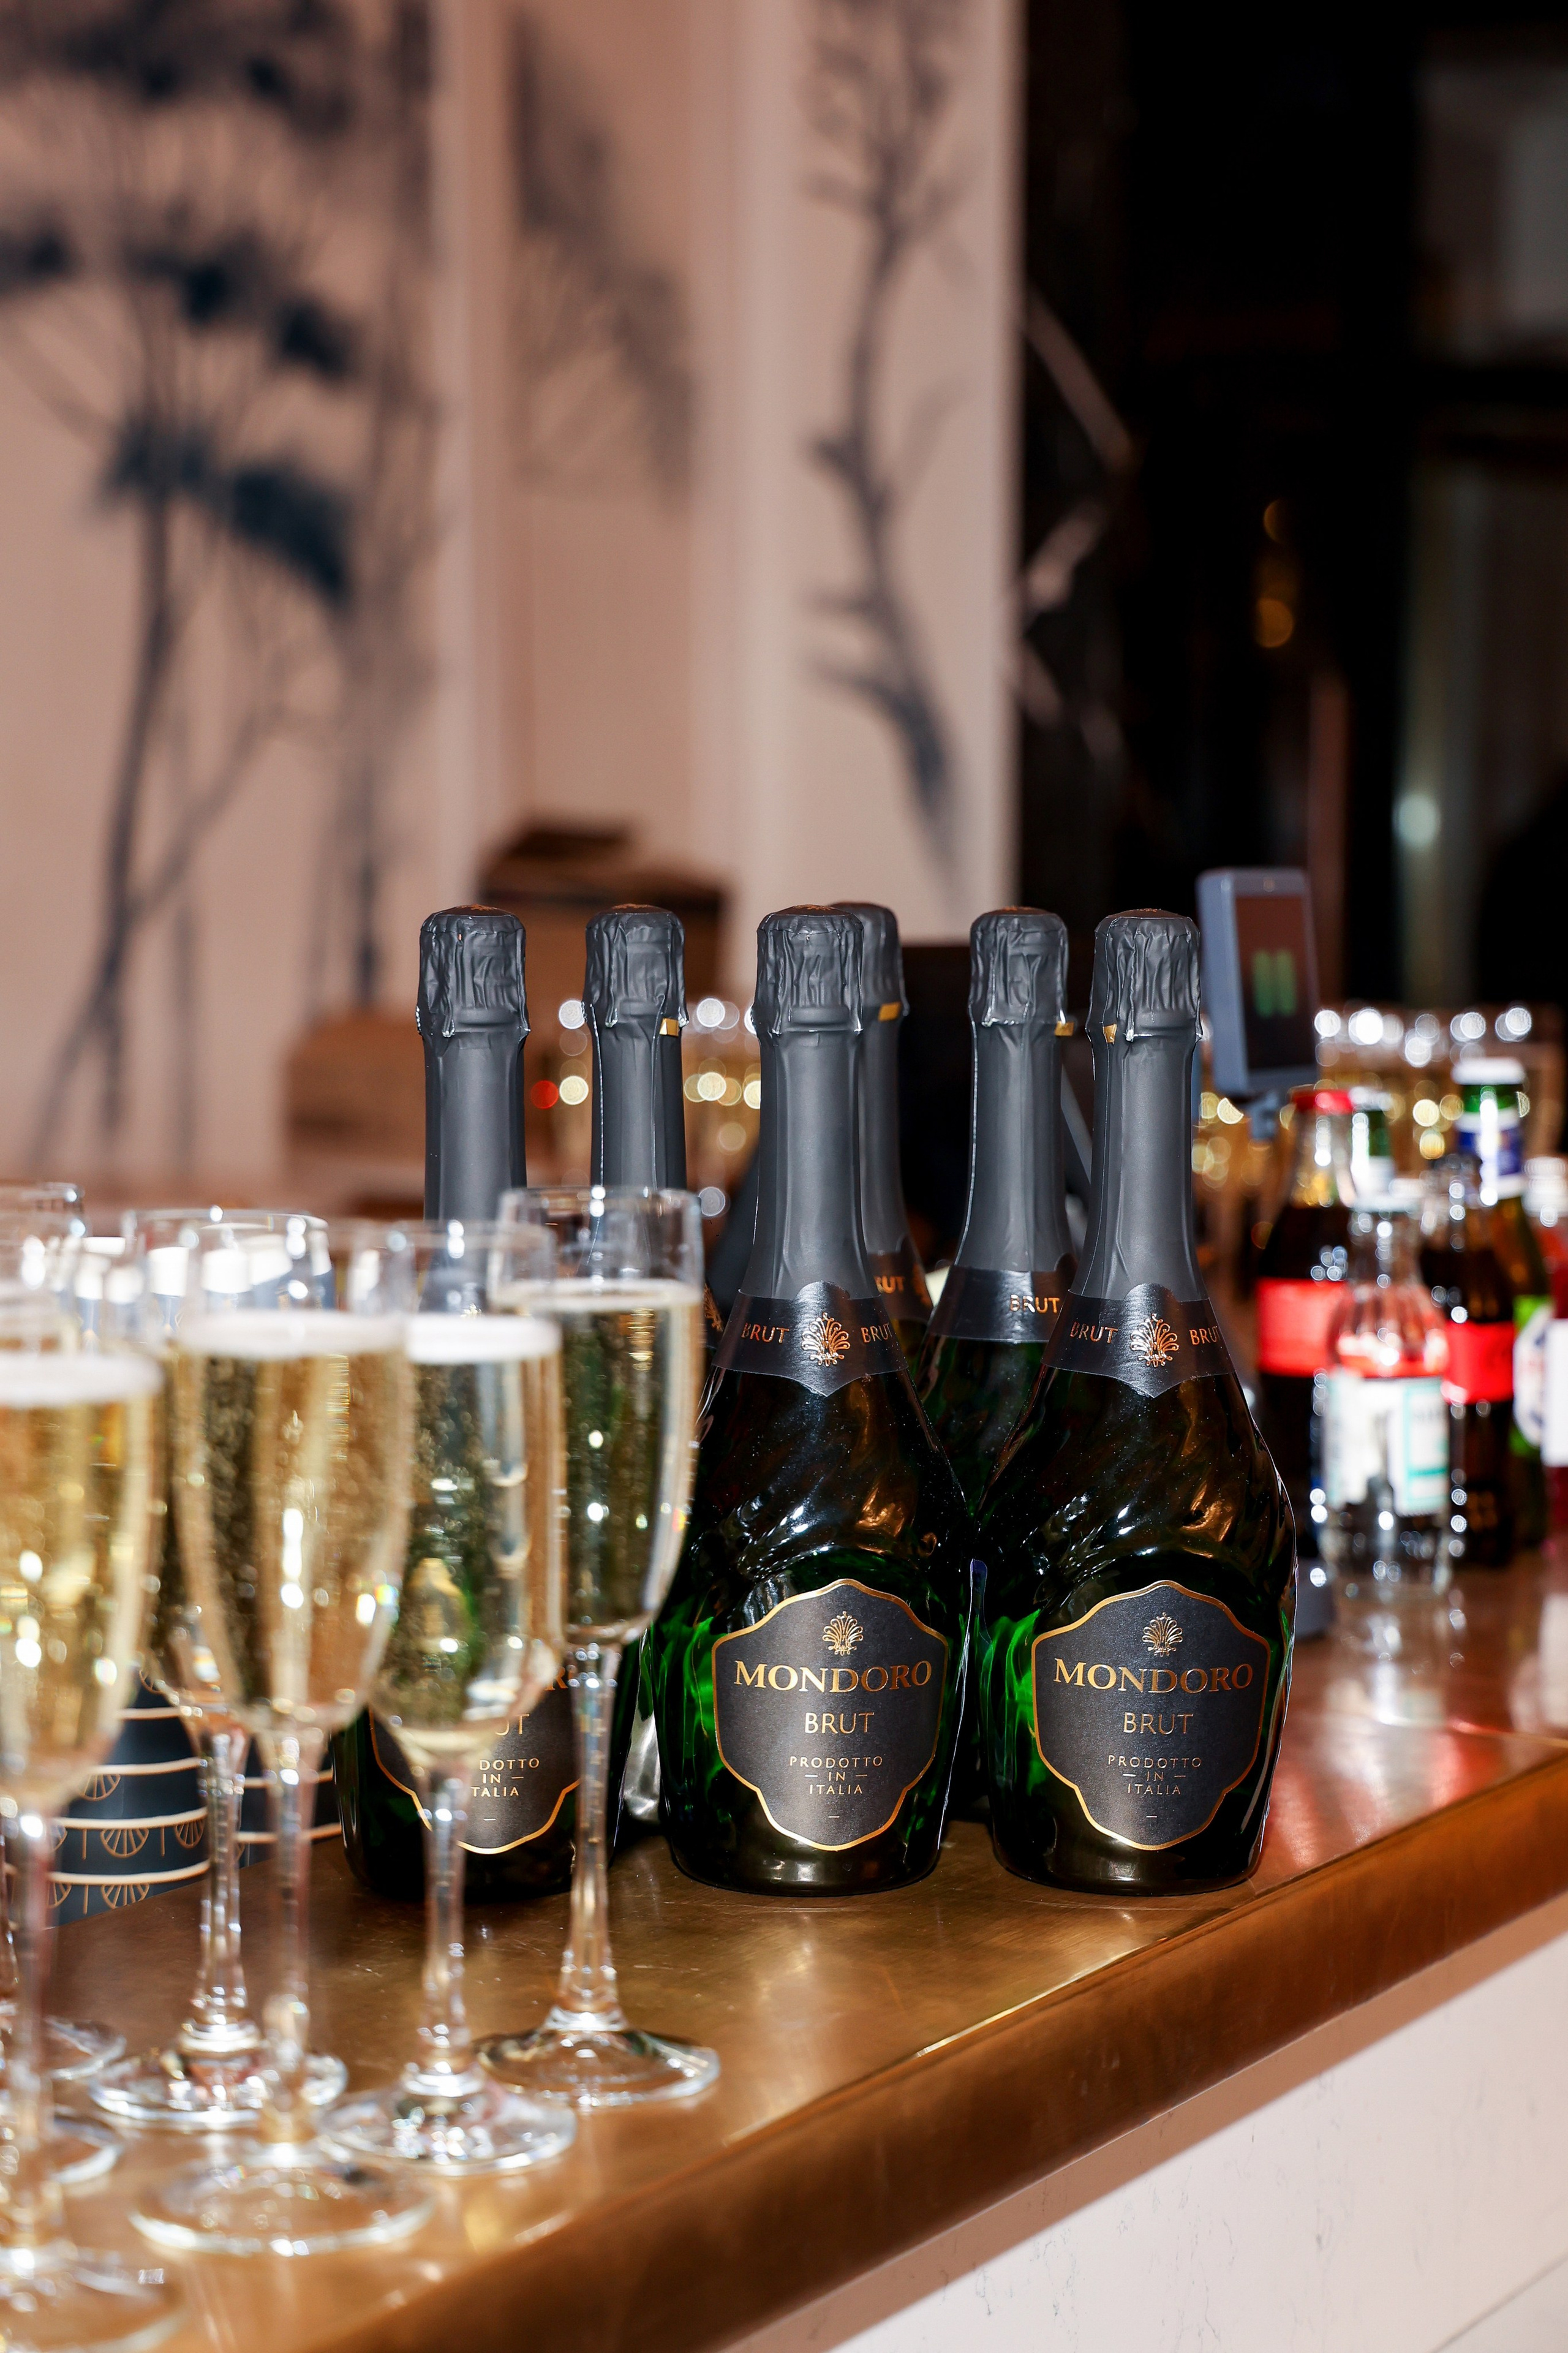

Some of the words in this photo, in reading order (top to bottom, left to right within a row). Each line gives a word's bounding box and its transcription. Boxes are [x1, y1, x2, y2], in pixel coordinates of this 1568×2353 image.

[874, 1275, 904, 1293] RUT
[1010, 1294, 1060, 1313] BRUT
[741, 1321, 790, 1344] BRUT
[861, 1323, 892, 1343] BRUT
[1069, 1321, 1118, 1344] BRUT
[734, 1660, 932, 1693] MONDORO
[1054, 1658, 1253, 1694] MONDORO
[804, 1712, 875, 1734] BRUT
[1123, 1712, 1194, 1735] BRUT
[479, 1758, 540, 1771] DOTTO
[790, 1755, 883, 1769] PRODOTTO
[1108, 1754, 1202, 1769] PRODOTTO
[482, 1773, 501, 1784] IN
[828, 1771, 845, 1781] IN
[1146, 1771, 1164, 1781] IN
[470, 1786, 519, 1797] TALIA
[809, 1784, 862, 1795] ITALIA
[1127, 1783, 1181, 1796] ITALIA
